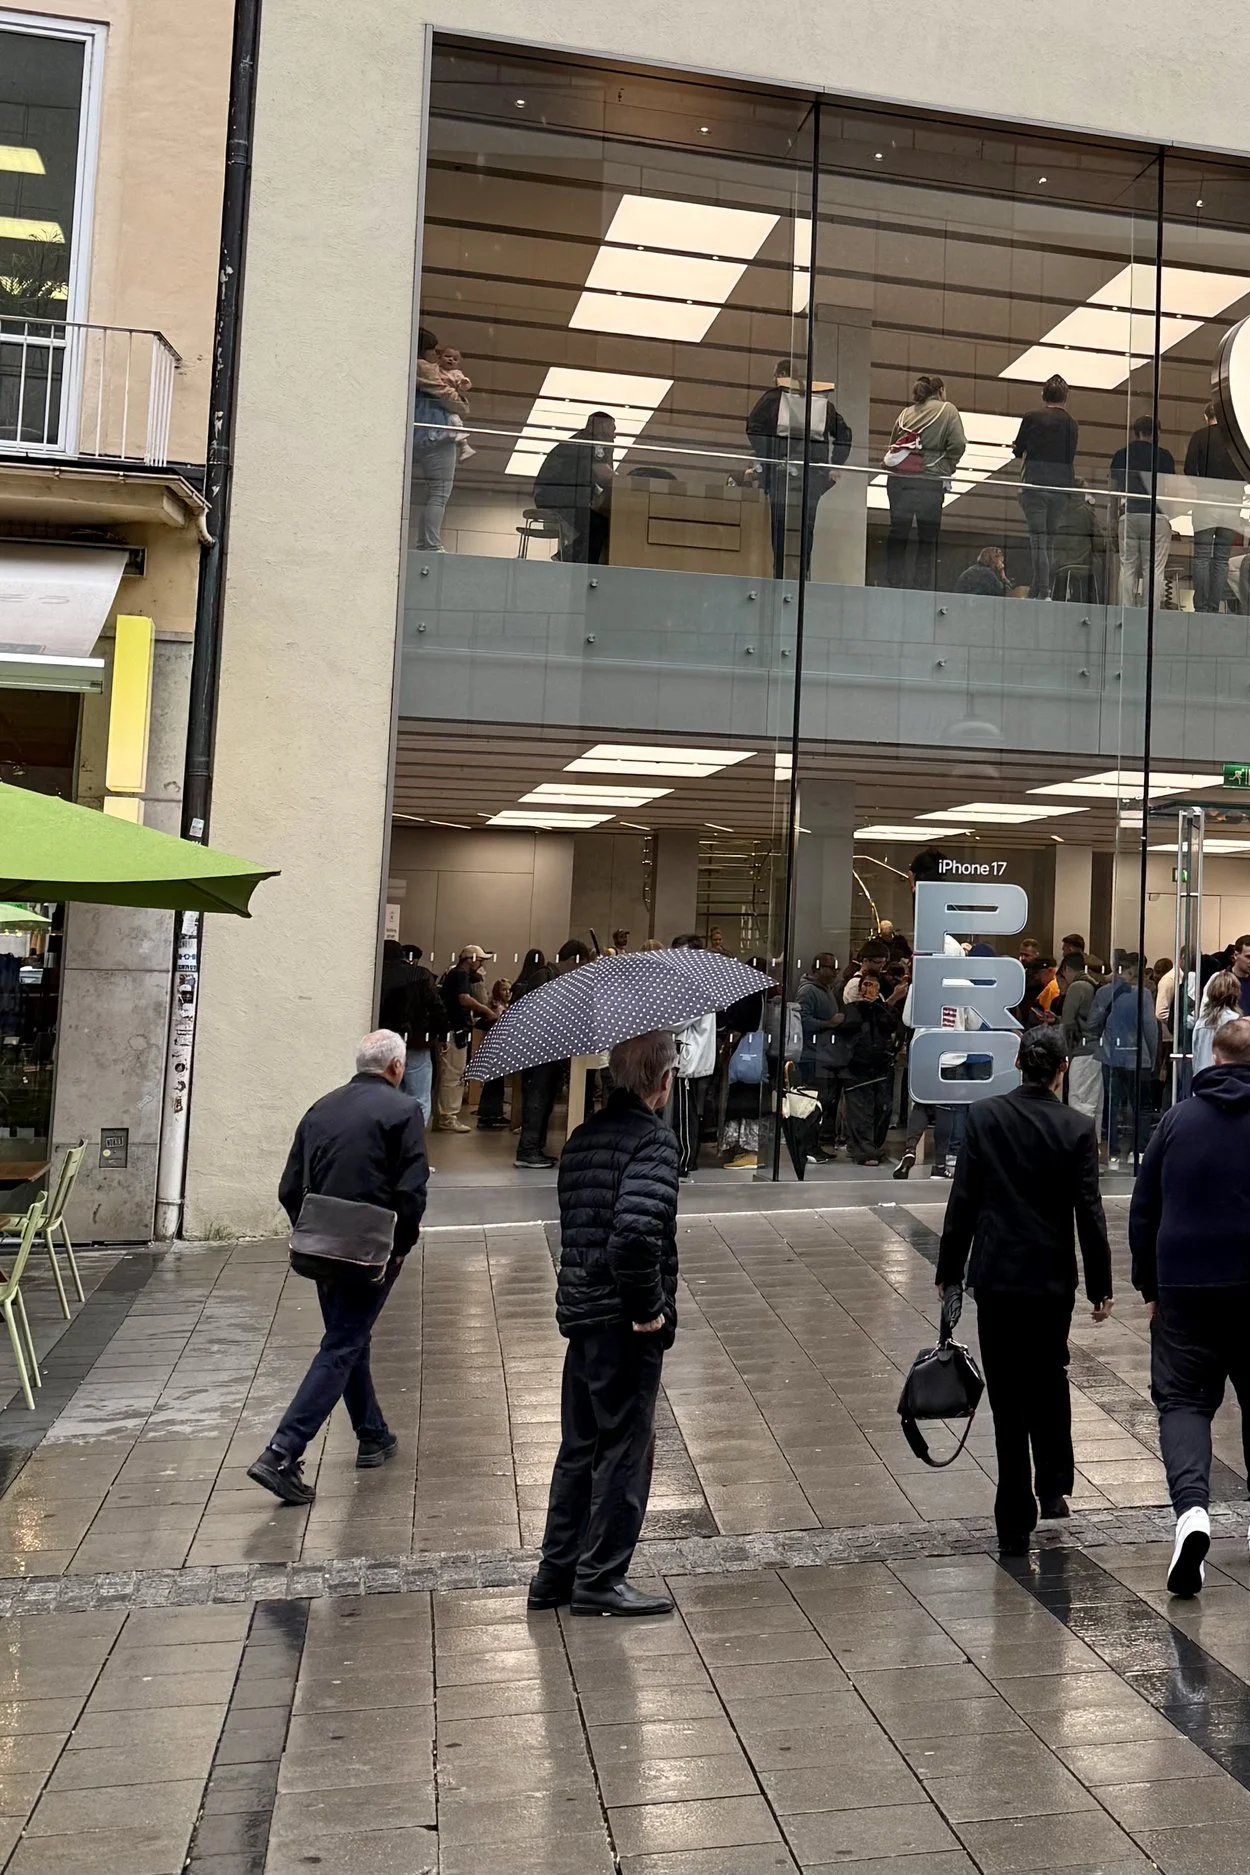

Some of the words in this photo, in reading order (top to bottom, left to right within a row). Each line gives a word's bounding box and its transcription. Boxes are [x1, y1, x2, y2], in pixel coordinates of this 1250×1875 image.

[938, 859, 990, 875] iPhone
[991, 861, 1008, 876] 17
[909, 881, 1029, 1104] PRO
